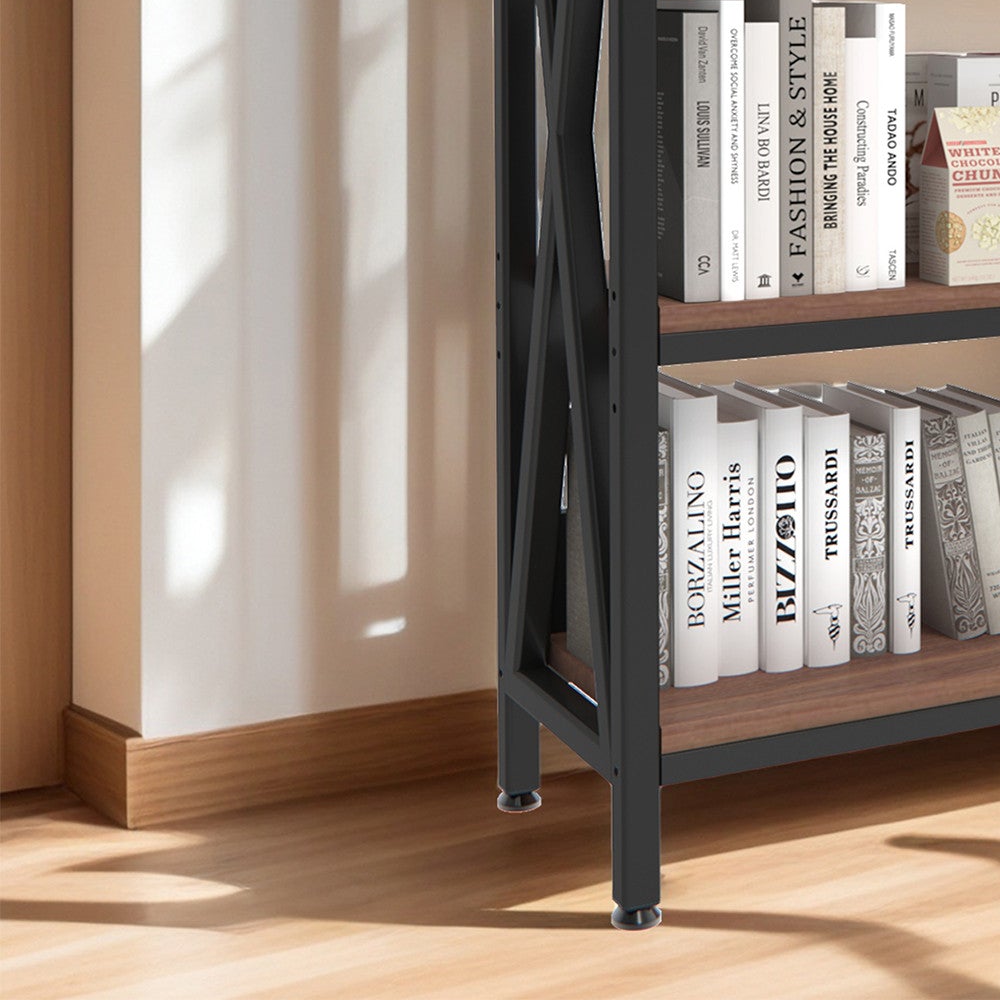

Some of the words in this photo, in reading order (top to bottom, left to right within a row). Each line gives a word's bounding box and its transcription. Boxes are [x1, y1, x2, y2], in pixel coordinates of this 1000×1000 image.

[729, 28, 739, 70] OVERCOME
[788, 16, 808, 100] STYLE
[729, 72, 739, 99] SOCIAL
[823, 72, 838, 104] HOME
[696, 100, 711, 125] LOUIS
[729, 100, 739, 132] ANXIETY
[757, 103, 771, 135] LINA
[788, 107, 808, 128] &
[823, 107, 838, 145] HOUSE
[853, 99, 871, 164] Constructing
[886, 108, 898, 150] TADAO
[696, 127, 711, 168] SULLIVAN
[729, 133, 739, 151] AND
[757, 138, 771, 158] BO
[823, 148, 838, 171] THE
[729, 152, 739, 185] SHYNESS
[757, 160, 771, 202] BARDI
[856, 165, 870, 207] Paradies
[886, 151, 898, 187] ANDO
[788, 137, 808, 257] FASHION
[823, 174, 838, 229] BRINGING
[697, 255, 711, 276] CCA
[888, 249, 898, 281] TASCEN
[722, 462, 741, 541] Harris
[747, 477, 755, 533] LONDON
[824, 448, 839, 561] TRUSSARDI
[904, 440, 915, 550] TRUSSARDI
[687, 470, 706, 629] BORZALINO
[775, 454, 797, 626] BIZZOTTO
[722, 548, 741, 623] Miller
[747, 539, 755, 604] PERFUMER
